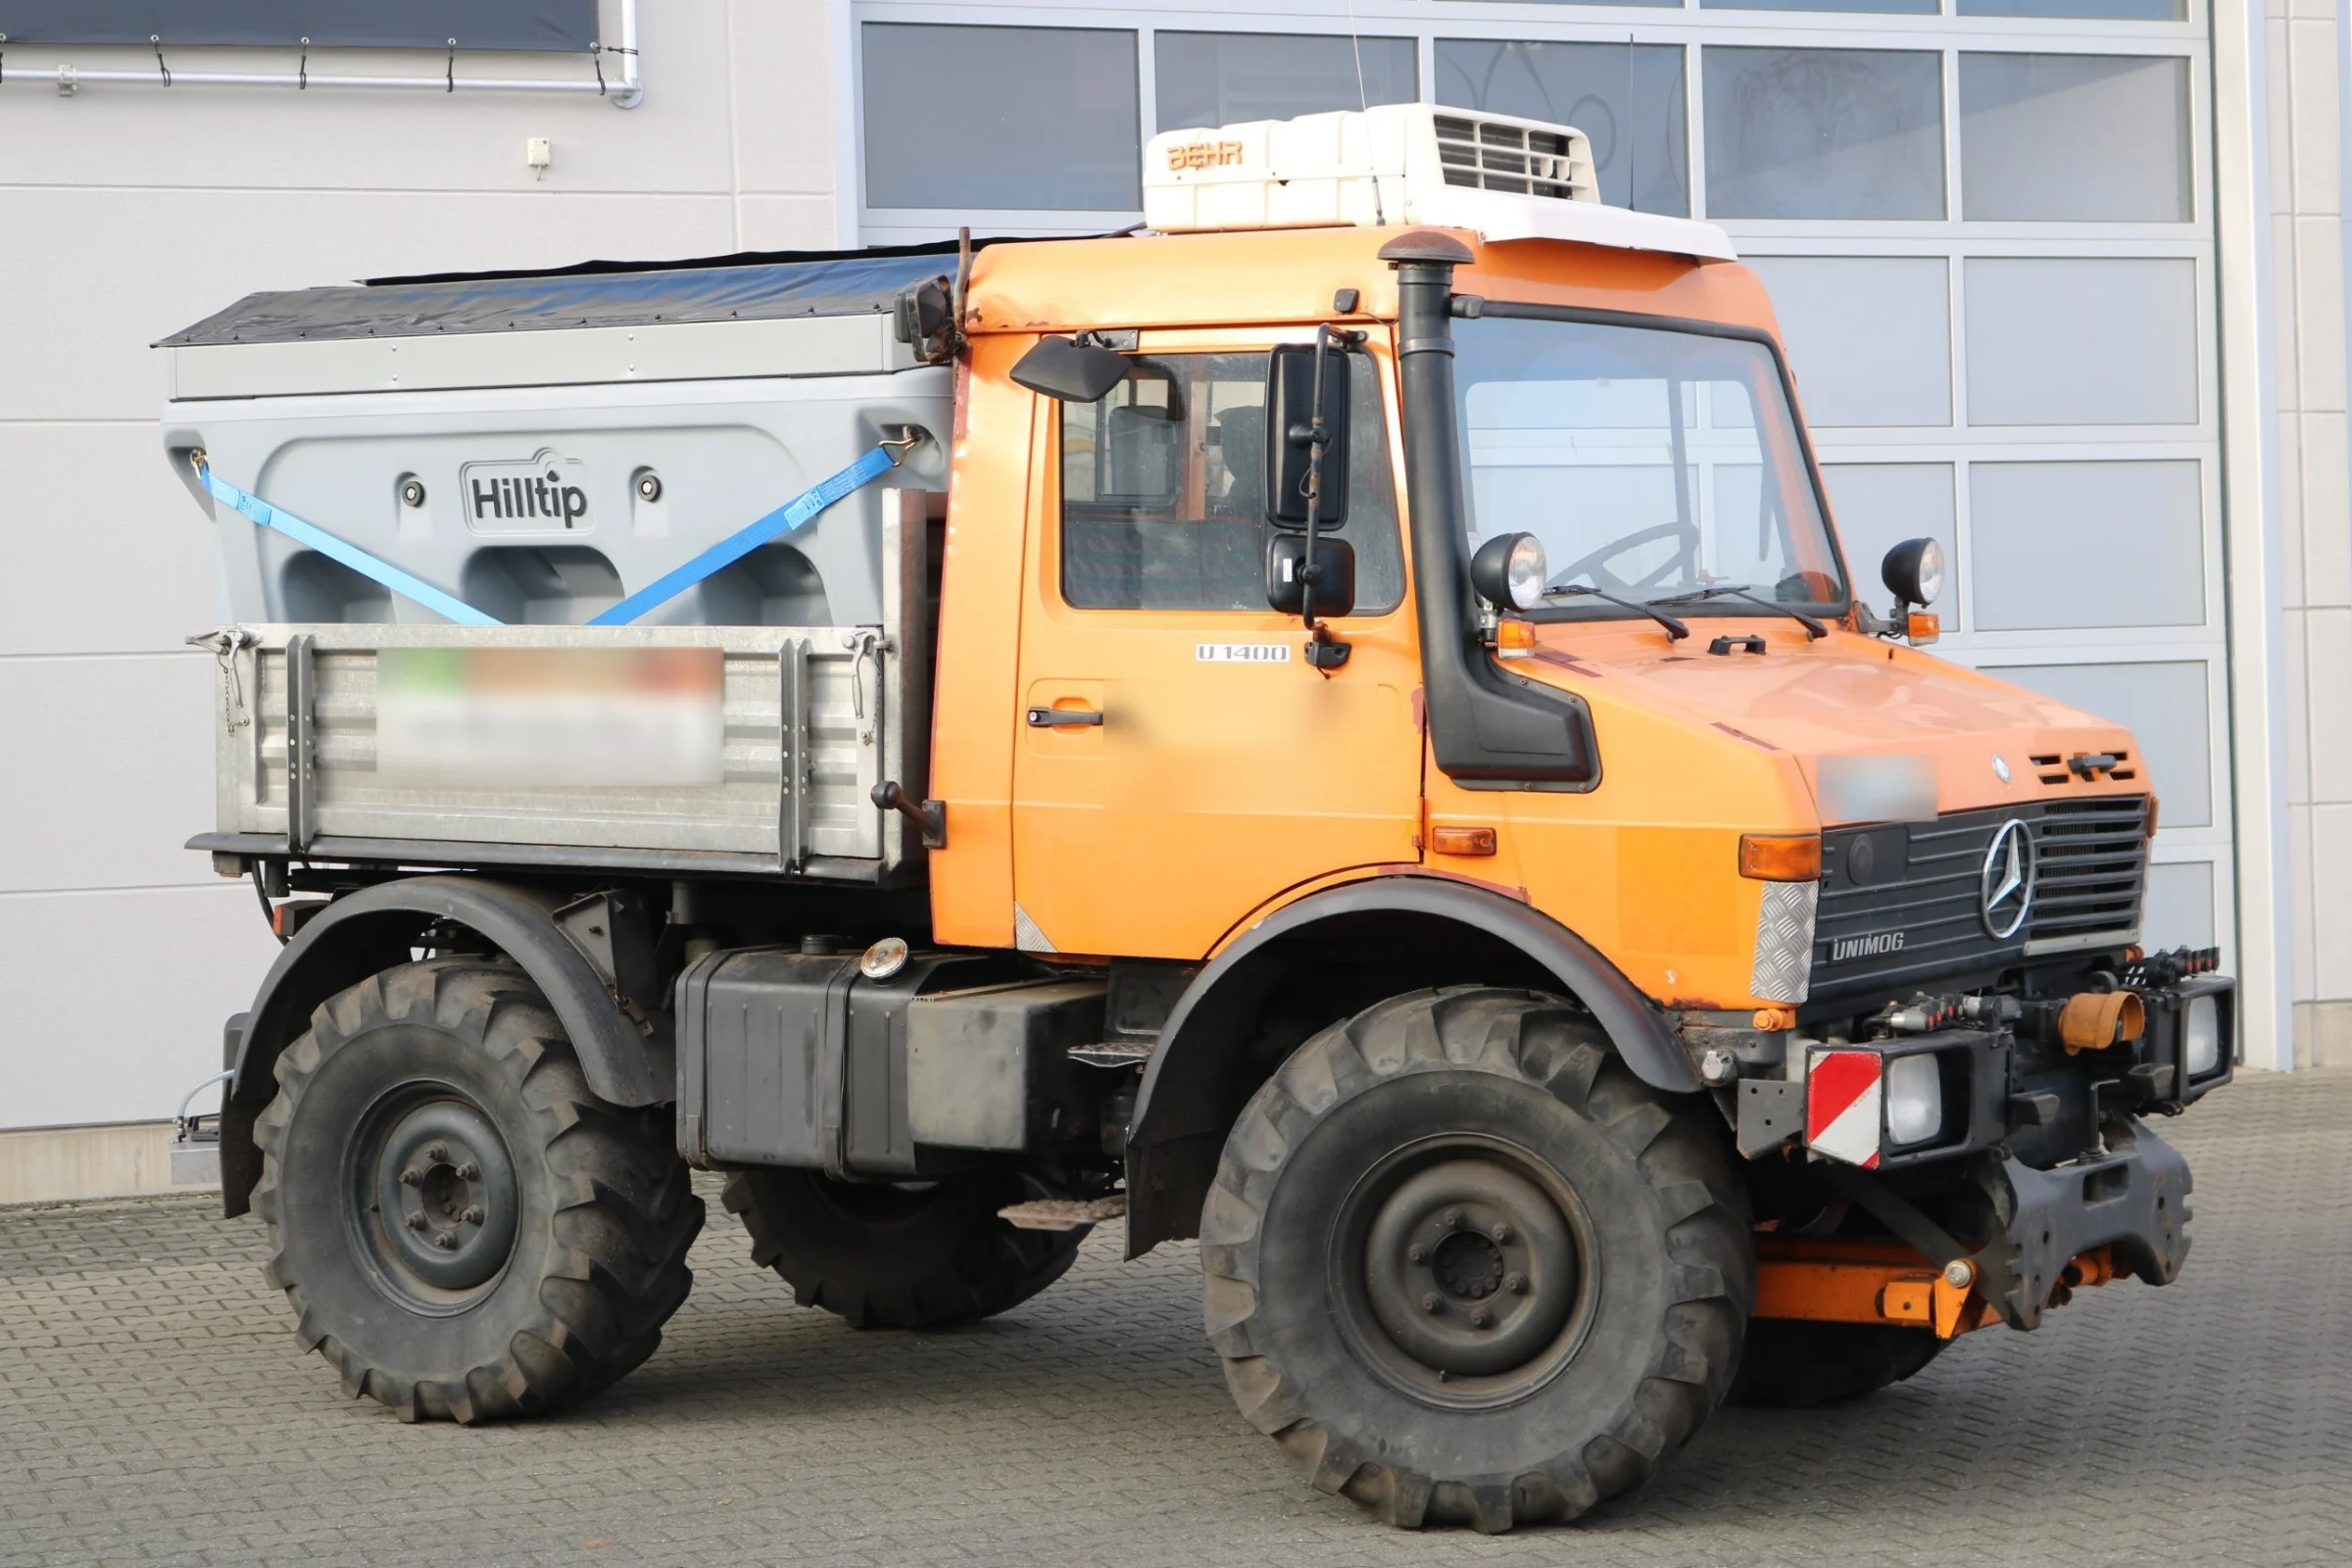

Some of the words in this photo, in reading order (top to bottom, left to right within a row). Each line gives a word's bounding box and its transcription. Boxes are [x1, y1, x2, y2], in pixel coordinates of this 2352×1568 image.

[1167, 141, 1243, 171] BEHR
[471, 469, 588, 529] Hilltip
[1199, 645, 1214, 660] U
[1223, 646, 1288, 661] 1400
[1833, 932, 1904, 960] UNIMOG
